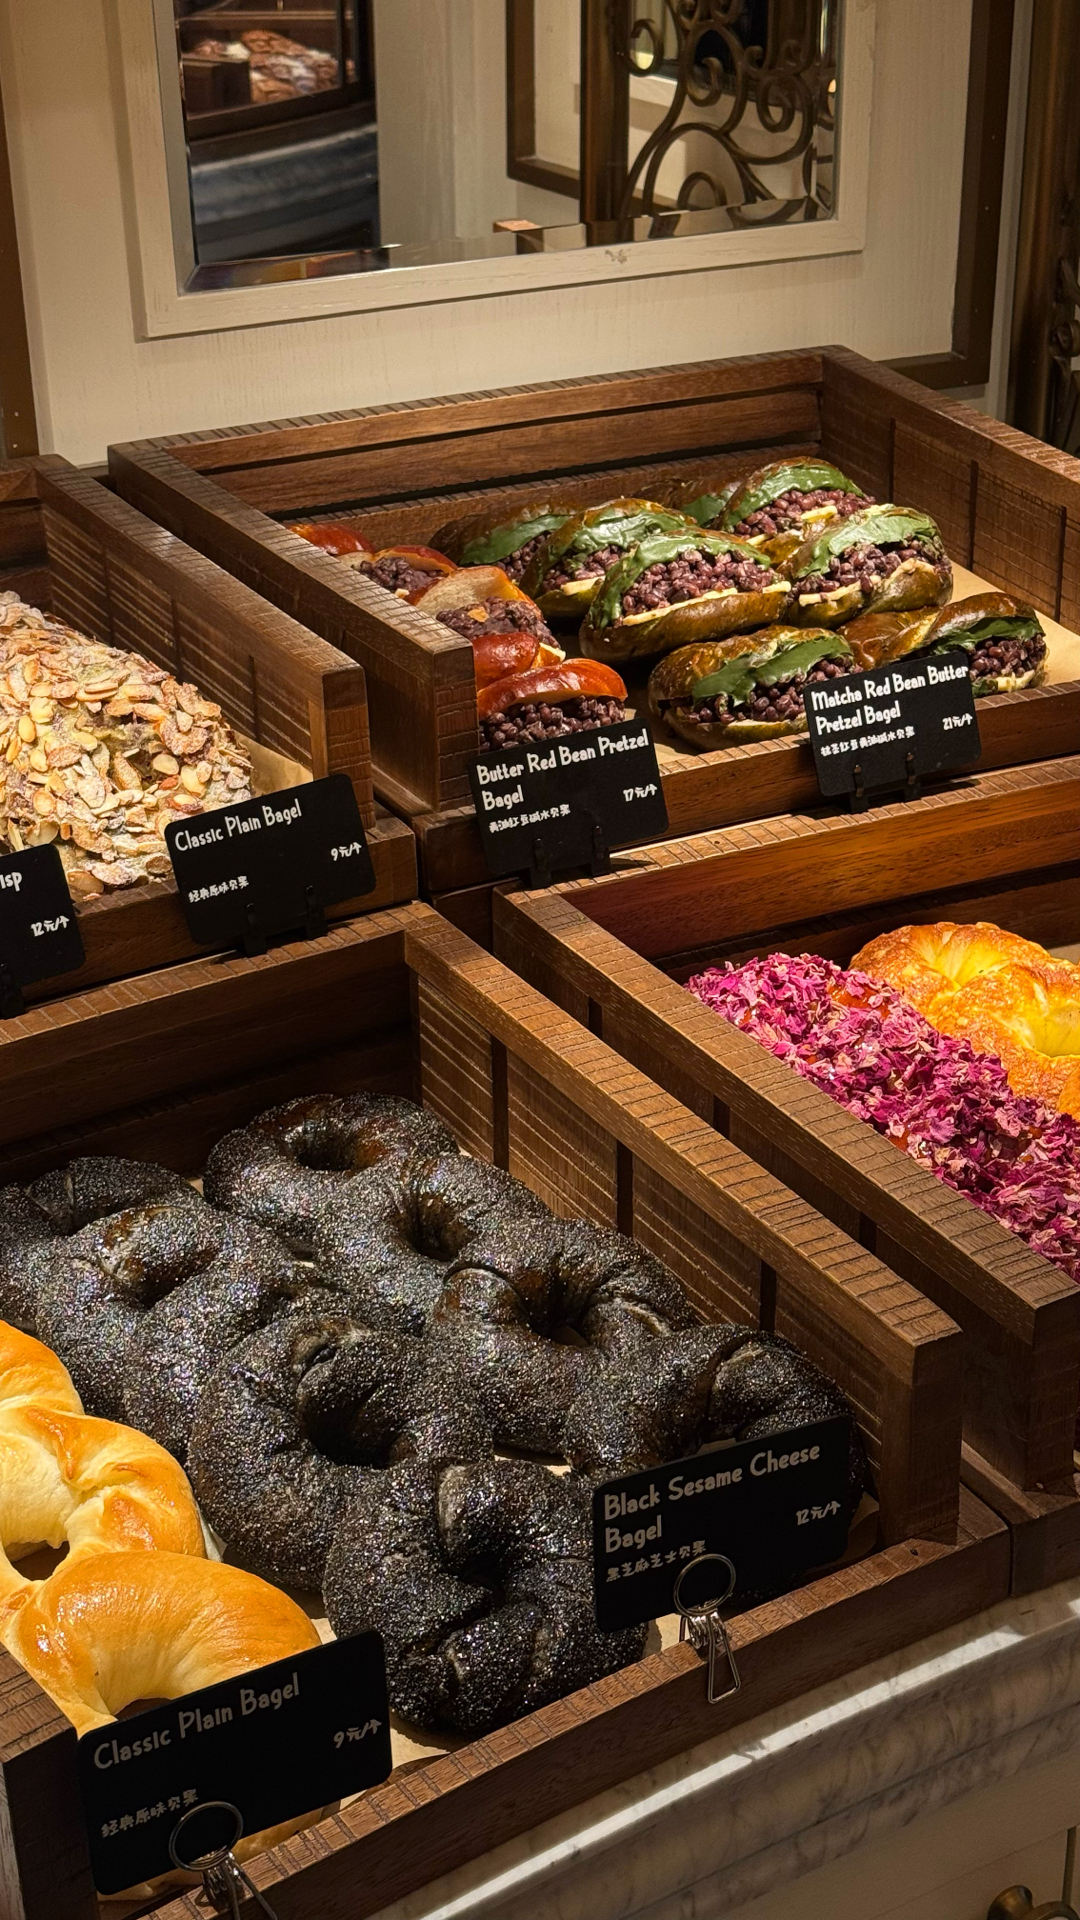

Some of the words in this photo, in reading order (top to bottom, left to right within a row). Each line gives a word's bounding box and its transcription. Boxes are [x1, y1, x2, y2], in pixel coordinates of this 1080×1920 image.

[811, 686, 862, 711] Matcha
[864, 677, 891, 699] Red
[892, 673, 926, 692] Bean
[927, 665, 968, 685] Butter
[815, 709, 862, 735] Pretzel
[864, 700, 901, 724] Bagel
[477, 764, 524, 786] Butter
[527, 750, 557, 773] Red
[558, 746, 596, 765] Bean
[598, 728, 649, 756] Pretzel
[482, 785, 524, 810] Bagel
[175, 829, 223, 851] Classic
[225, 816, 261, 837] Plain
[262, 798, 302, 826] Bagel
[189, 876, 249, 902] 经典原味贝果
[31, 916, 70, 937] 12元/个
[604, 1484, 661, 1521] Black
[669, 1469, 742, 1500] Sesame
[750, 1446, 819, 1476] Cheese
[606, 1514, 661, 1554] Bagel
[796, 1501, 840, 1525] 12元/个
[606, 1539, 706, 1582] 黑芝麻芝士贝果
[93, 1728, 171, 1769] Classic
[179, 1708, 233, 1738] Plain
[240, 1672, 299, 1715] Bagel
[101, 1789, 198, 1838] 经典原味贝果
